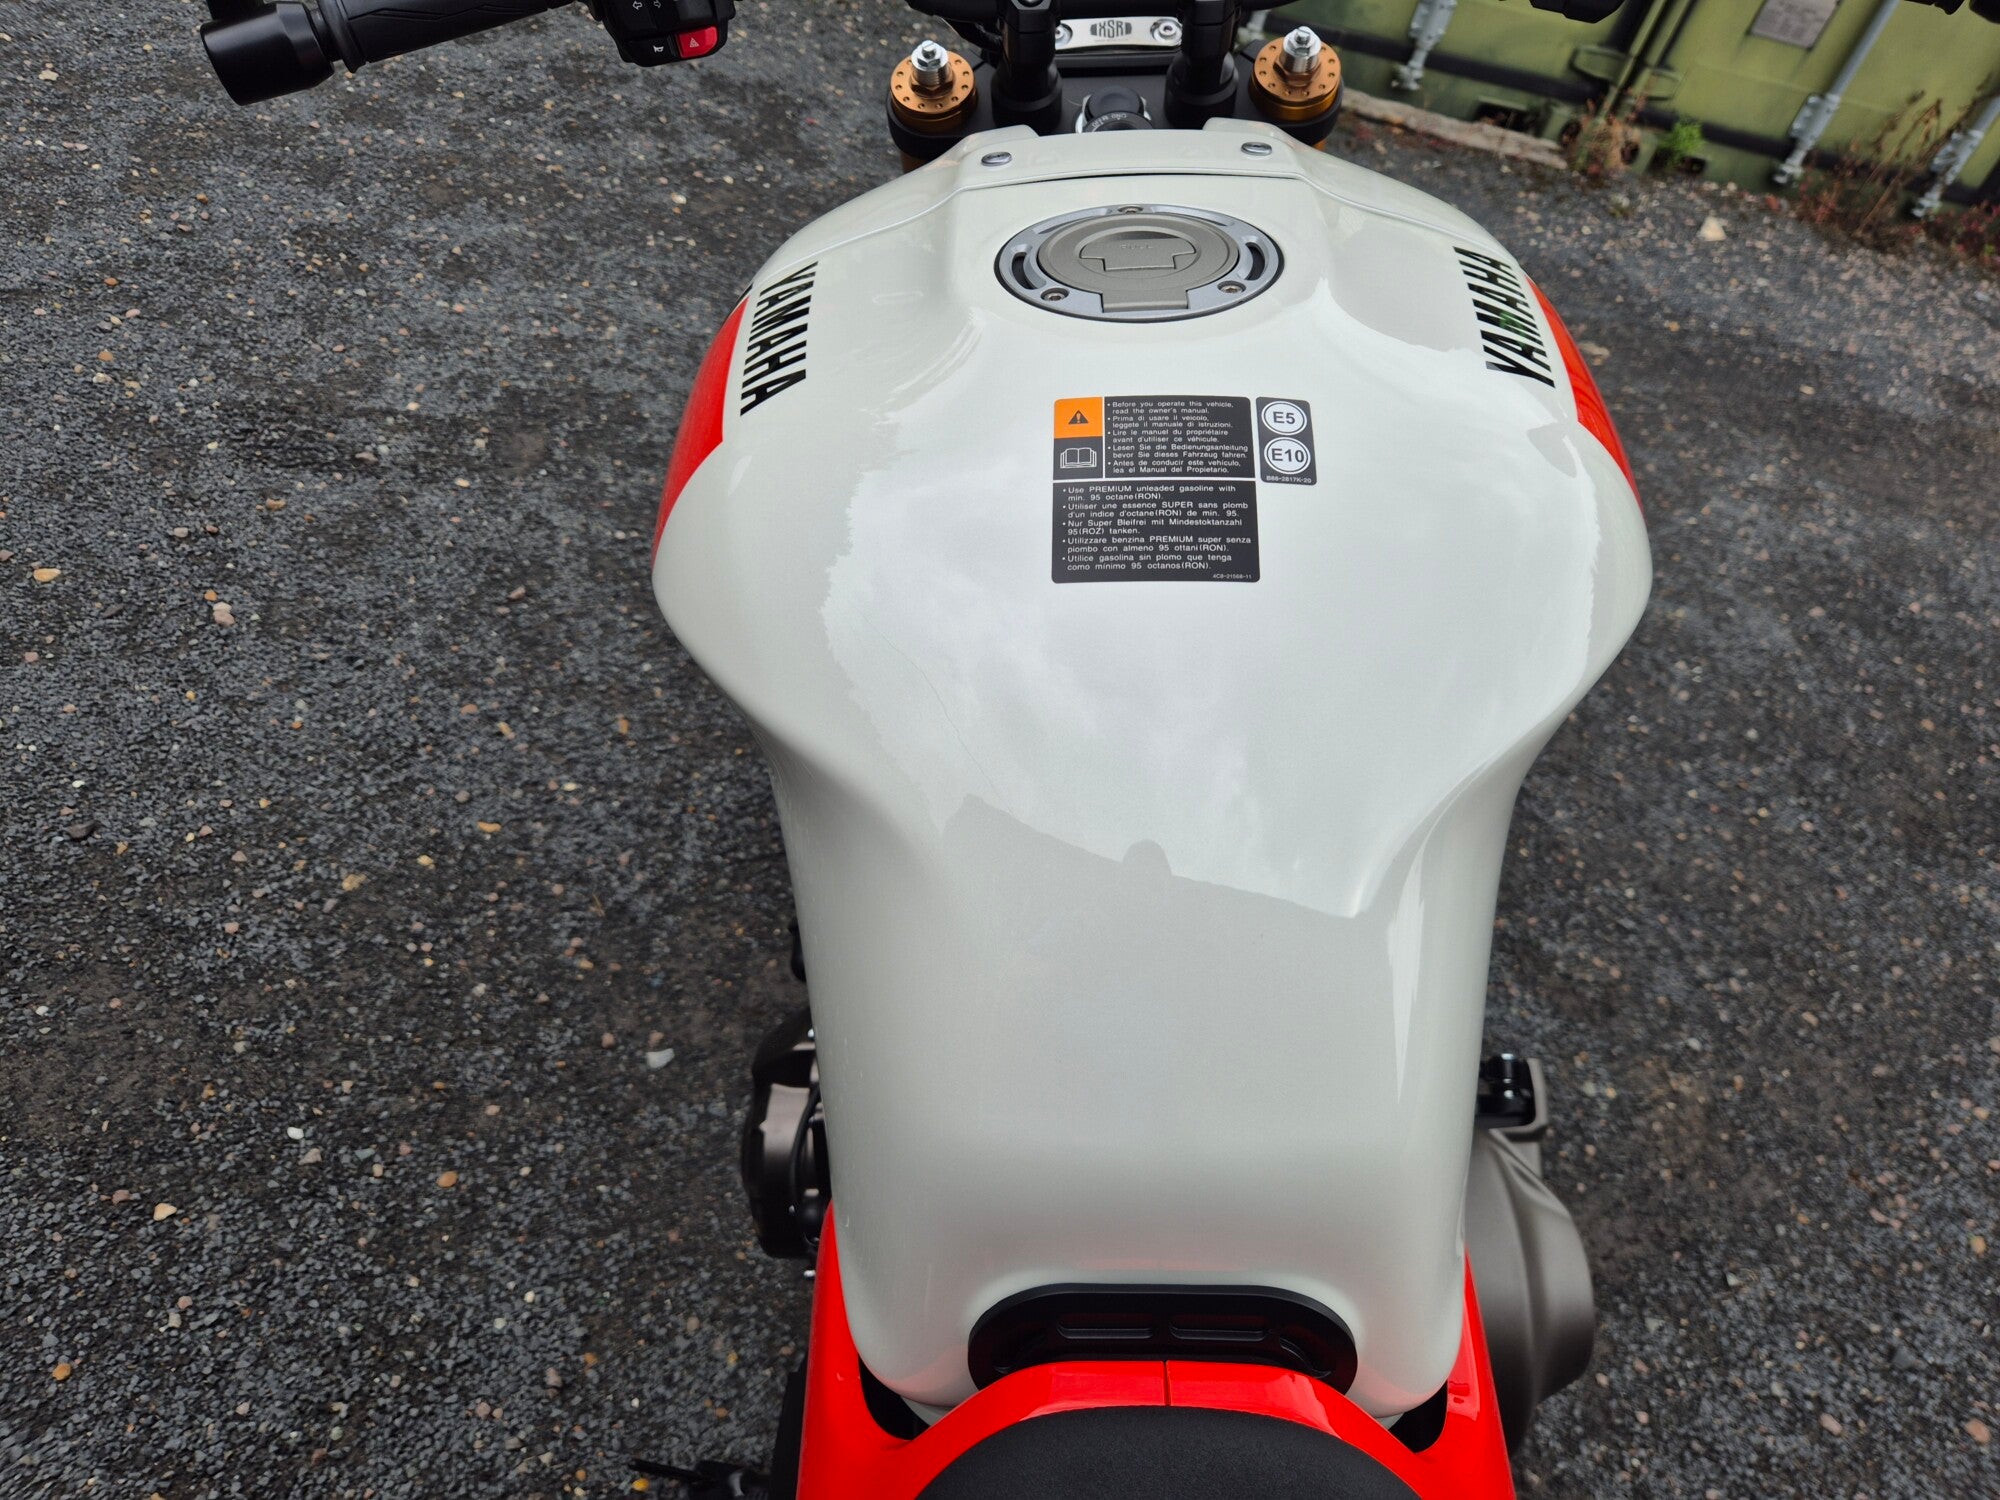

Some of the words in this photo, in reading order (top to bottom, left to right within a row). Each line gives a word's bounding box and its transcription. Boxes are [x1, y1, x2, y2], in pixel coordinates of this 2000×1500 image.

[1098, 19, 1124, 39] XSR
[1452, 246, 1556, 389] YAMAHA
[740, 261, 819, 417] YAMAHA
[1273, 411, 1296, 425] E5
[1112, 422, 1140, 430] leggete
[1139, 443, 1152, 451] Sie
[1170, 443, 1249, 453] Bedienungsanleitung
[1112, 451, 1134, 459] bevor
[1182, 450, 1218, 460] Fahrzeug
[1271, 448, 1305, 463] E10
[1112, 459, 1135, 467] Antes
[1089, 485, 1132, 493] PREMIUM
[1179, 485, 1214, 493] gasoline
[1090, 493, 1101, 501] 95
[1067, 503, 1097, 511] Utiliser
[1161, 501, 1194, 509] SUPER
[1222, 502, 1249, 510] plomb
[1090, 510, 1115, 518] indice
[1087, 519, 1113, 528] Super
[1169, 518, 1243, 526] Mindestoktanzahl
[1109, 527, 1141, 535] tanken.
[1067, 537, 1108, 545] Utilizzare
[1149, 535, 1194, 543] PREMIUM
[1198, 536, 1222, 544] super
[1067, 546, 1099, 555] piombo
[1067, 555, 1094, 563] Utilice
[1098, 554, 1134, 562] gasolina
[1156, 553, 1182, 562] plomo
[1207, 553, 1232, 562] tenga
[1131, 562, 1142, 570] 95
